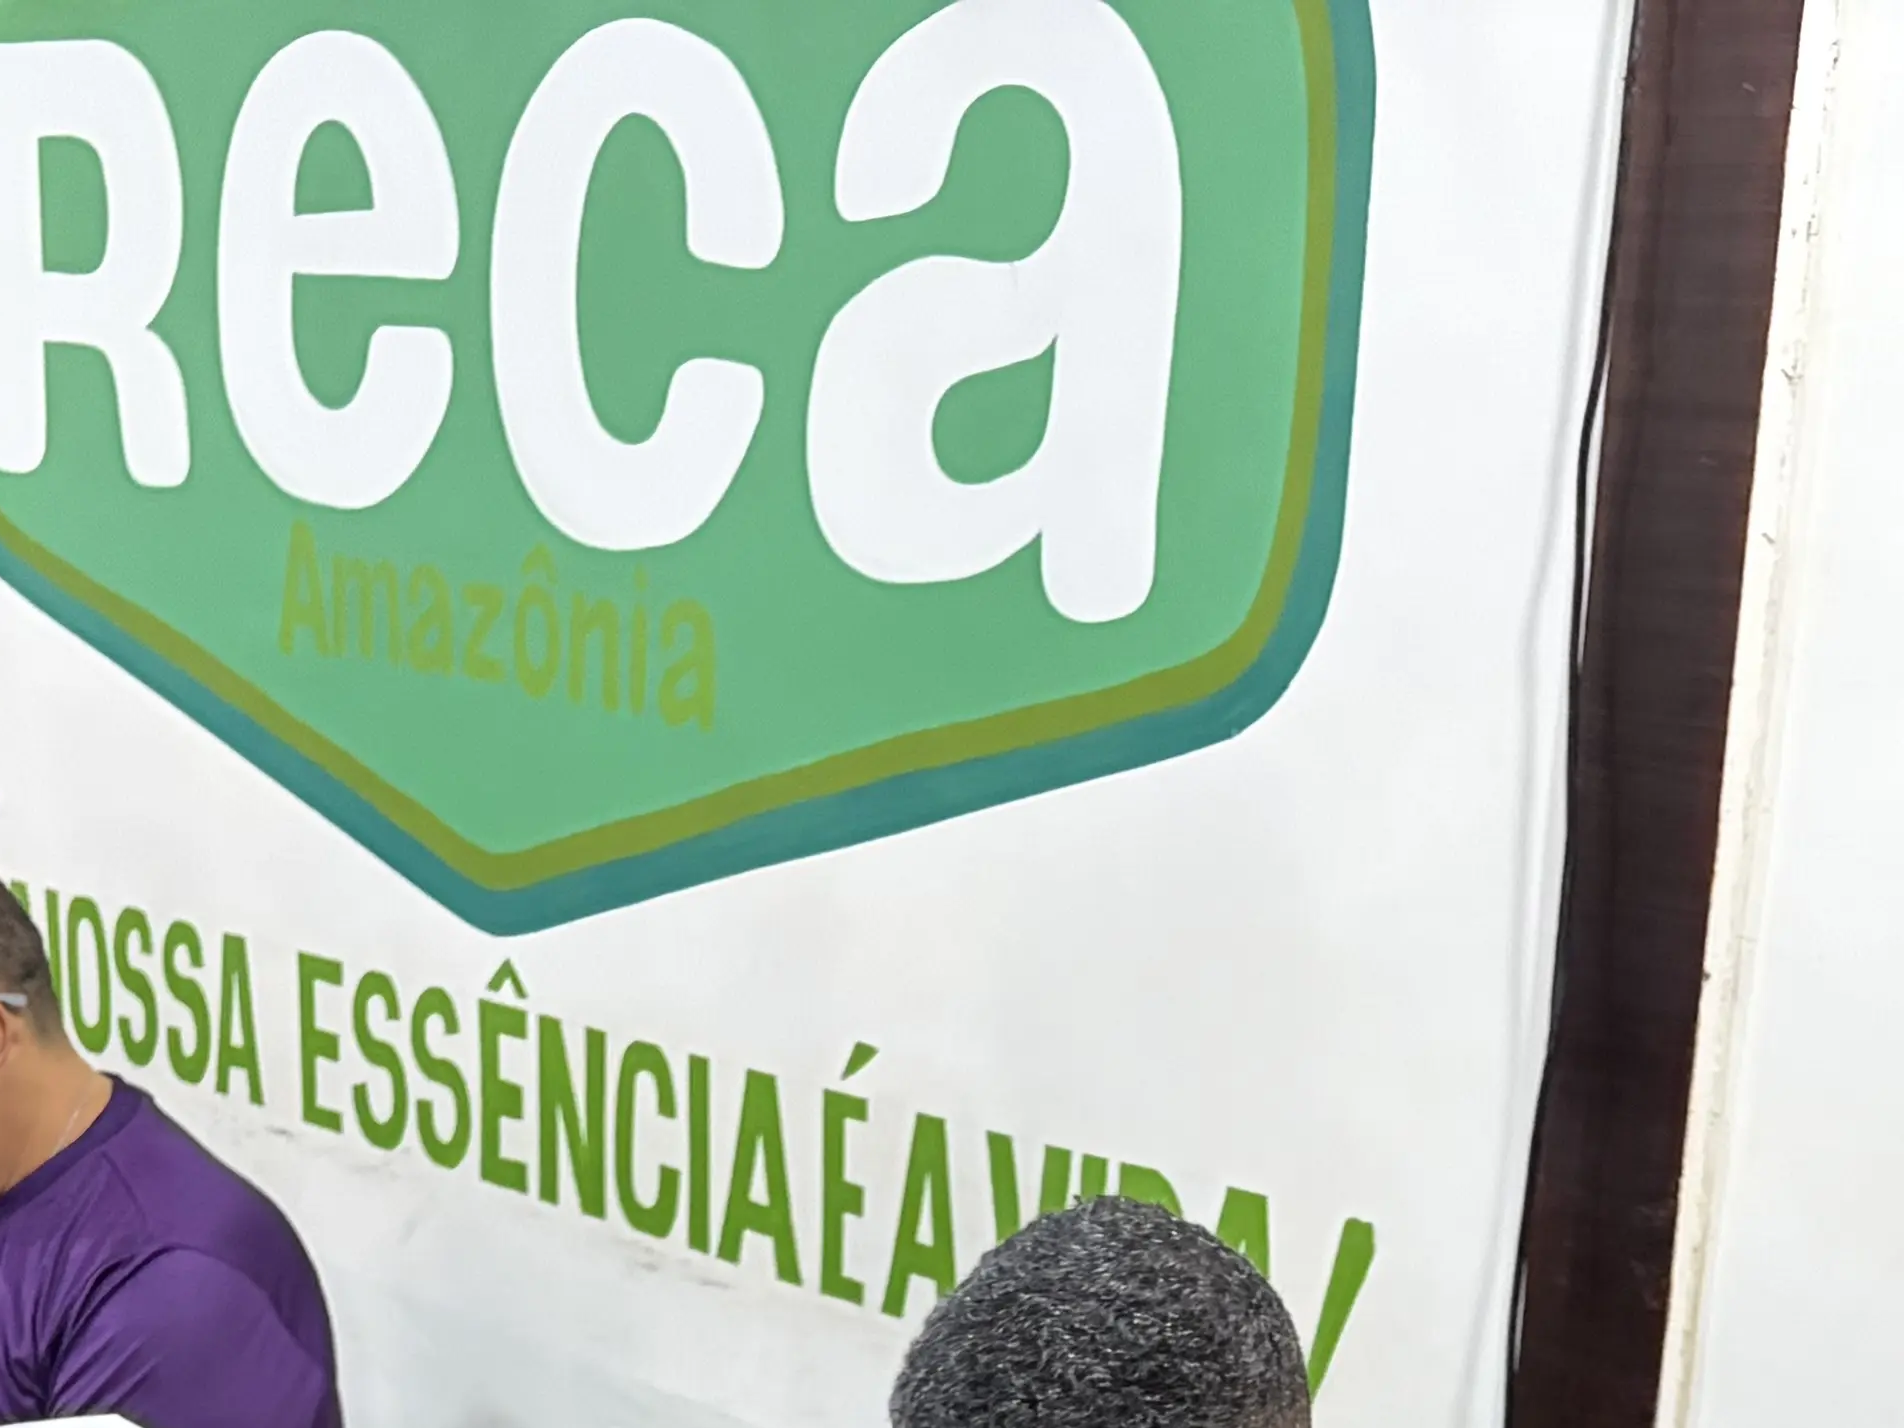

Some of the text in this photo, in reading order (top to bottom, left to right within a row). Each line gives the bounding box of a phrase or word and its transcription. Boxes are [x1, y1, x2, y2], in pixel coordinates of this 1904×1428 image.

[277, 522, 716, 731] Amazônia
[296, 958, 805, 1287] ESSÊNCIA
[819, 1040, 880, 1307] É
